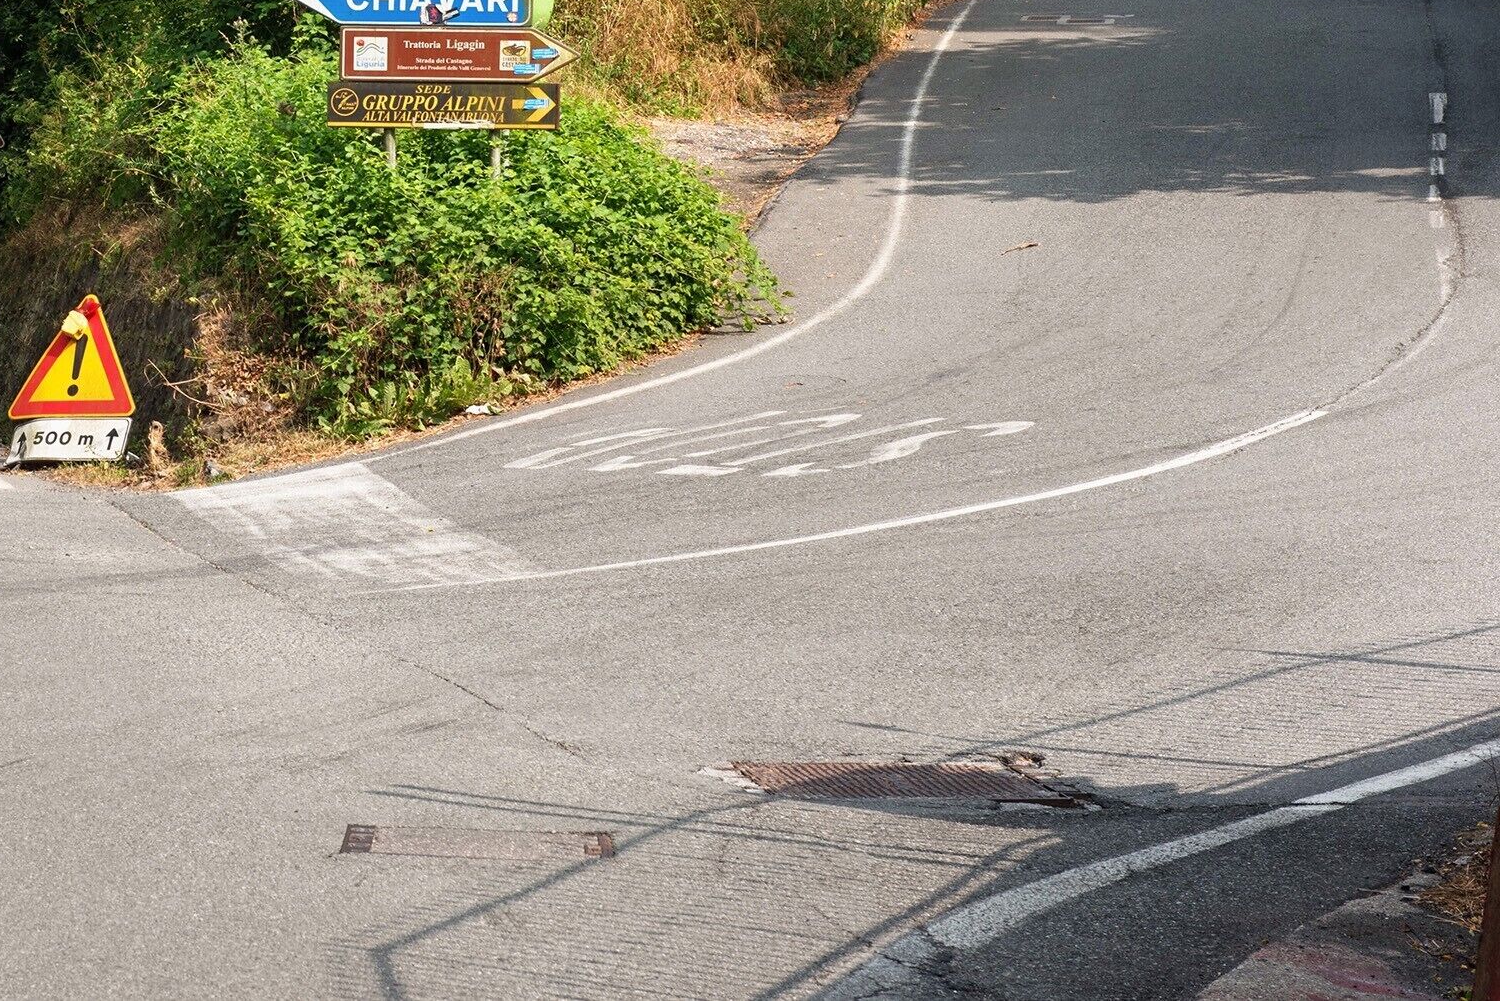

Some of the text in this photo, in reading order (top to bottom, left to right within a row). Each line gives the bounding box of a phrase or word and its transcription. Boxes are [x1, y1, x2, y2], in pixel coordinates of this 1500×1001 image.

[403, 39, 485, 51] Trattoria Ligagin
[415, 84, 452, 94] SEDE
[362, 94, 439, 111] GRUPPO
[440, 95, 507, 112] ALPINI
[362, 110, 390, 122] ALTA
[33, 431, 94, 446] 500 m
